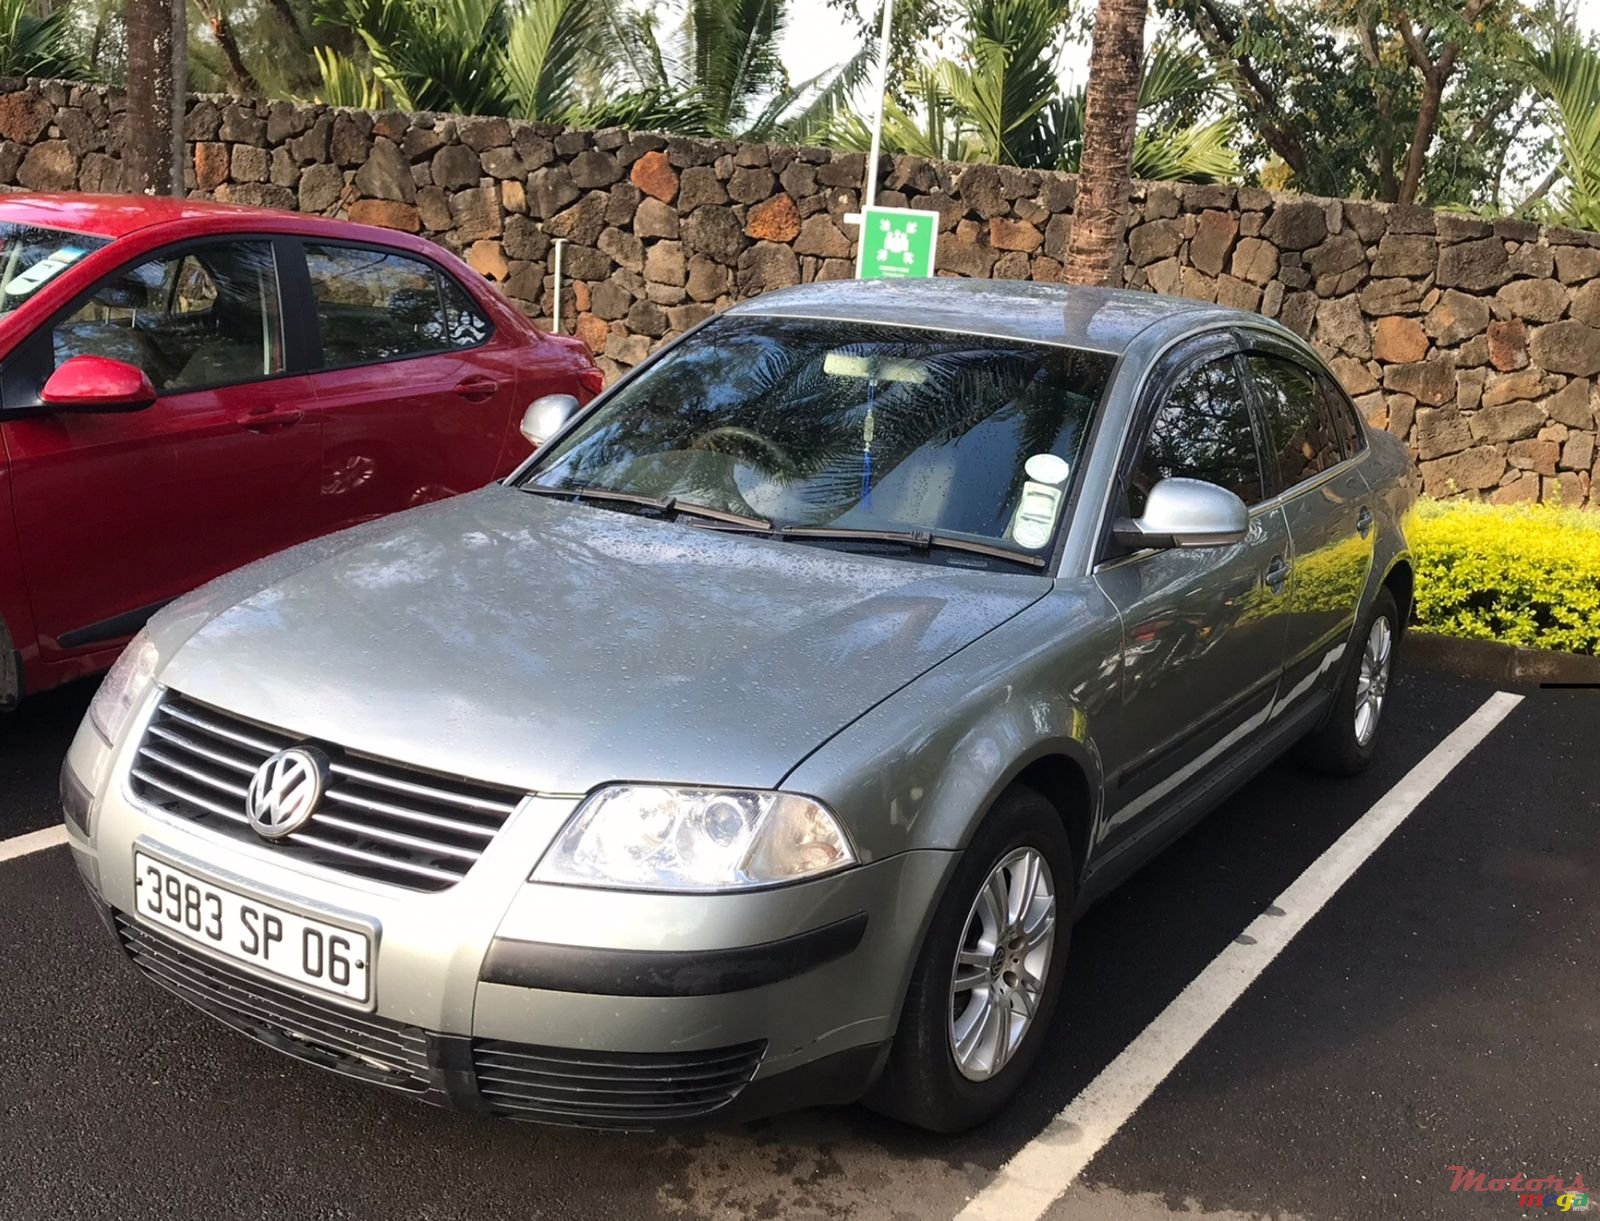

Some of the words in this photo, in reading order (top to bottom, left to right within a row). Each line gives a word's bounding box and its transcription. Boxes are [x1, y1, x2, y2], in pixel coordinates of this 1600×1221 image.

[146, 866, 223, 942] 3983
[240, 905, 283, 960] SP
[302, 926, 350, 987] 06
